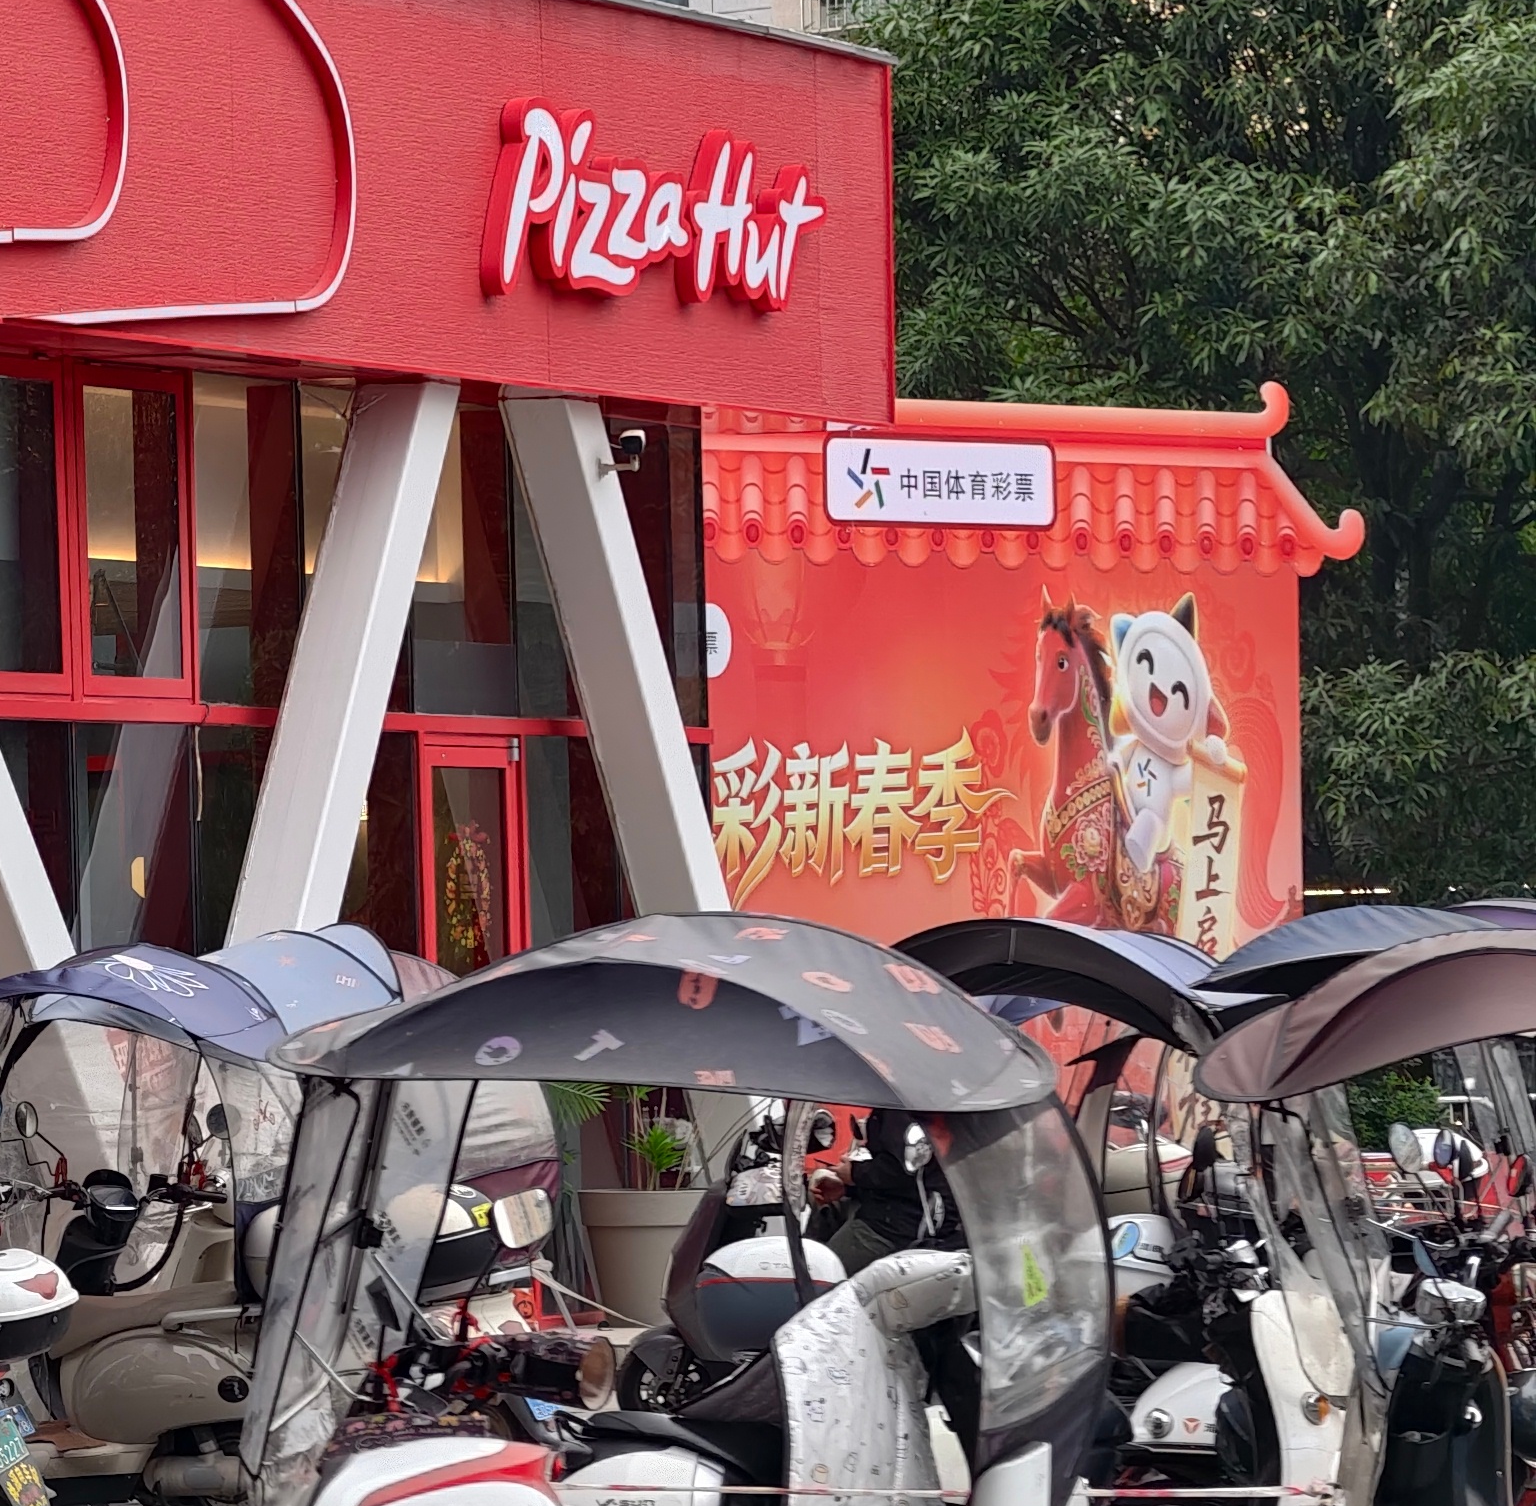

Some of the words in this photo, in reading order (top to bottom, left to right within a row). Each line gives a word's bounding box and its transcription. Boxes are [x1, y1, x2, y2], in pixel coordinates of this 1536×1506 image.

[503, 107, 689, 286] Pizza
[693, 140, 825, 301] Hut
[900, 468, 1035, 502] 中国体育彩票
[712, 725, 1018, 911] 彩新春季
